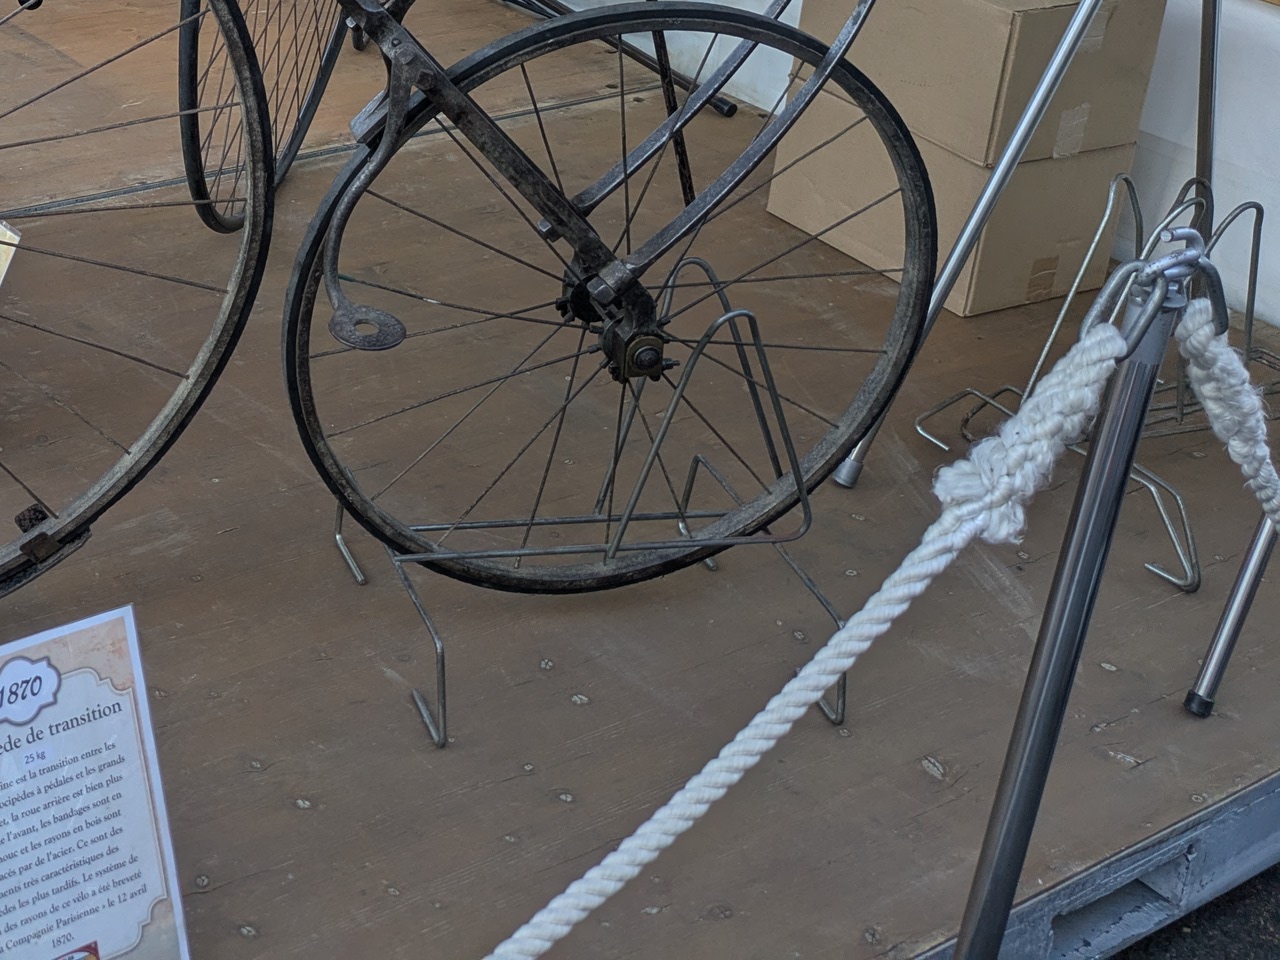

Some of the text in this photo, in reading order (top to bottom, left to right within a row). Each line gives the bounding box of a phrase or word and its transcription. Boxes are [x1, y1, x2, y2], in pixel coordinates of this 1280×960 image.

[26, 726, 44, 744] de
[49, 702, 122, 736] transition
[15, 774, 27, 784] est
[28, 770, 37, 779] la
[39, 756, 79, 775] transition
[81, 747, 102, 760] entre
[104, 742, 116, 751] les
[24, 751, 46, 764] 25 kg
[37, 786, 42, 795] à
[44, 776, 74, 794] pédales
[75, 771, 84, 780] et
[85, 766, 96, 776] les
[98, 755, 125, 773] grands
[6, 825, 38, 841] l'avant,
[40, 819, 52, 829] les
[53, 805, 90, 824] bandages
[92, 796, 110, 808] sont
[111, 792, 122, 801] en
[11, 812, 19, 822] la
[21, 806, 41, 818] roue
[43, 795, 70, 810] arrière
[72, 789, 83, 799] est
[85, 782, 104, 794] bien
[105, 775, 123, 788] plus
[18, 863, 32, 875] par
[35, 856, 45, 867] de
[46, 847, 75, 862] l'acier.
[76, 839, 88, 849] Ce
[90, 832, 108, 844] sont
[110, 827, 123, 837] des
[20, 846, 29, 855] et
[30, 841, 42, 851] les
[44, 830, 71, 845] rayons
[73, 825, 84, 834] en
[84, 816, 102, 829] bois
[103, 809, 121, 821] sont
[18, 899, 30, 908] les
[32, 892, 50, 905] plus
[51, 878, 80, 895] tardifs.
[82, 873, 93, 883] Le
[95, 861, 126, 877] système
[128, 854, 138, 864] de
[23, 878, 39, 889] très
[41, 853, 104, 882] caractéristiques
[106, 846, 119, 856] des
[4, 922, 18, 933] des
[20, 911, 47, 926] rayons
[49, 904, 59, 914] de
[62, 900, 71, 909] ce
[72, 891, 89, 903] vélo
[98, 882, 110, 894] été
[112, 870, 141, 888] breveté
[6, 925, 53, 950] Compagnie
[56, 906, 99, 929] Parisienne
[107, 898, 115, 907] le
[118, 892, 127, 903] 12
[130, 883, 147, 899] avril
[51, 932, 74, 949] 1870.
